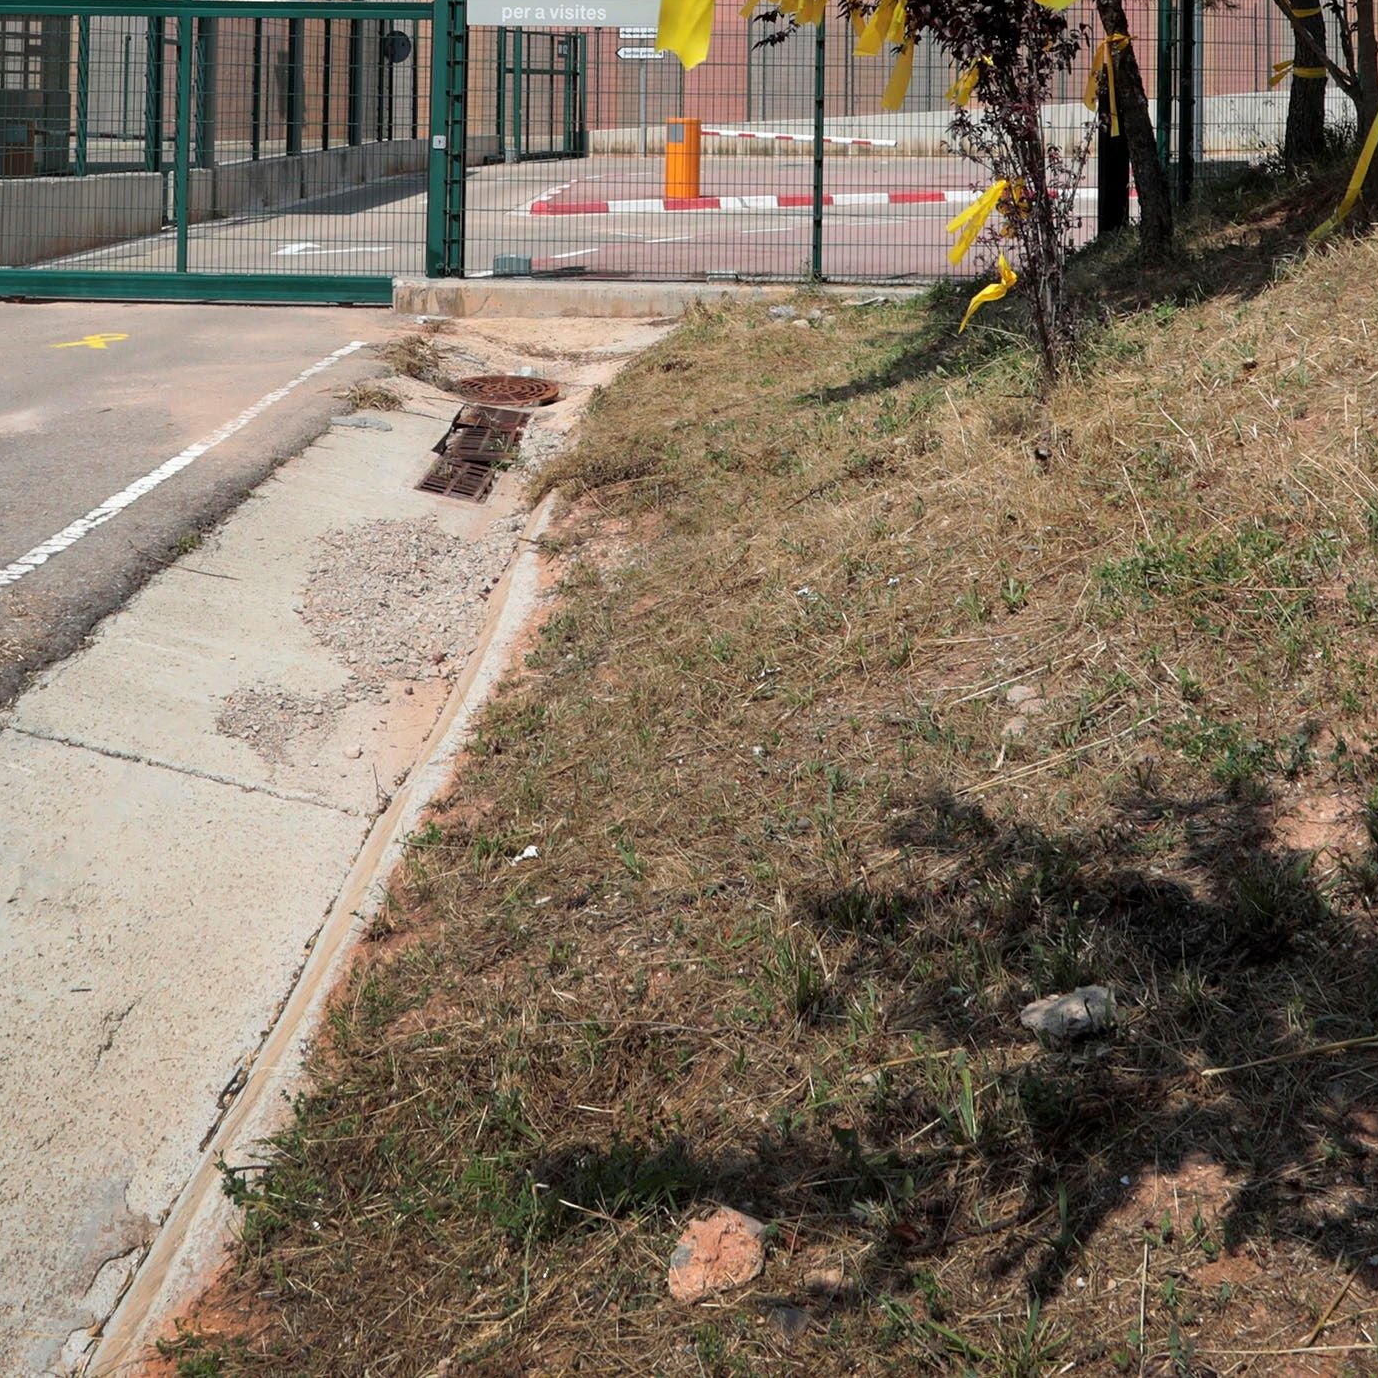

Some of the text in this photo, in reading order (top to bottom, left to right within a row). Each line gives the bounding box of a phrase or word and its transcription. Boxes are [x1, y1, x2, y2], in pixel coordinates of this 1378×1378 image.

[502, 4, 607, 22] per a visites
